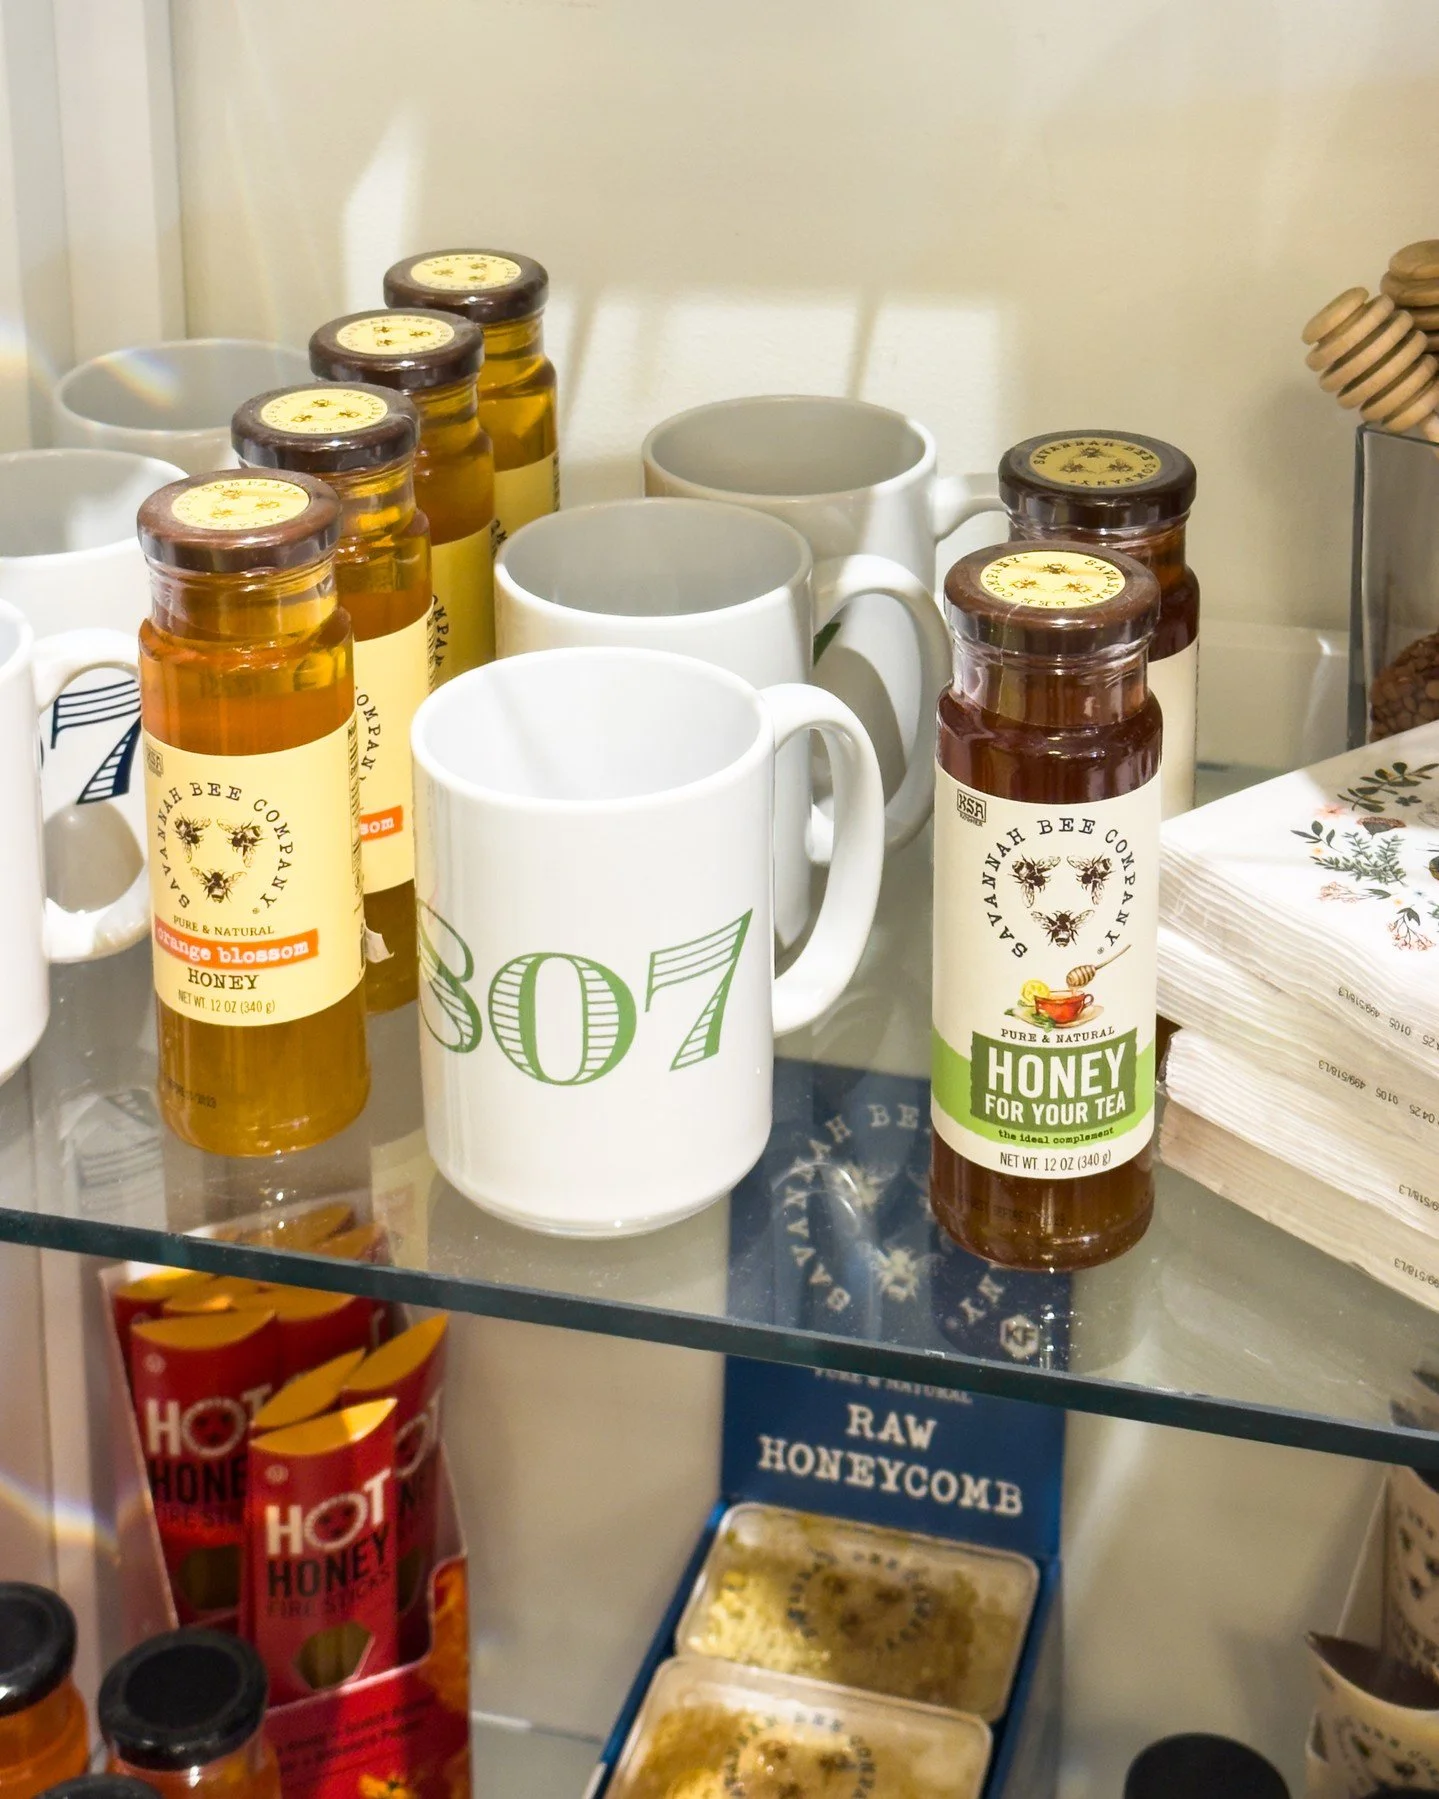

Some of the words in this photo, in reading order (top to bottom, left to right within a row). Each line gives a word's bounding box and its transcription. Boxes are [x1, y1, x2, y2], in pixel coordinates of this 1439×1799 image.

[157, 787, 190, 908] SAVANNAH
[189, 782, 242, 801] BEE
[253, 799, 294, 908] COMPANY
[981, 827, 1028, 958] SAVANNAH
[1036, 817, 1096, 836] BEE
[1104, 828, 1137, 947] COMPANY
[173, 914, 199, 932] PURE
[202, 926, 211, 935] &
[214, 925, 275, 937] NATURAL
[156, 926, 212, 962] orange
[217, 940, 310, 964] blossom
[187, 966, 260, 990] HONEY
[178, 989, 193, 1003] NET
[210, 999, 221, 1012] 12
[224, 1001, 237, 1014] OZ
[240, 1000, 263, 1015] (340
[1001, 1028, 1037, 1042] PURE
[1041, 1035, 1050, 1044] &
[1056, 1026, 1115, 1044] NATURAL
[1388, 1017, 1412, 1037] 0105
[988, 1042, 1126, 1100] HONEY
[985, 1093, 1024, 1124] FOR
[1031, 1101, 1088, 1126] YOUR
[1094, 1090, 1126, 1120] TEA
[1375, 1087, 1399, 1105] 0105
[868, 1104, 932, 1136] BE
[998, 1129, 1017, 1141] the
[1020, 1132, 1049, 1144] ideal
[1053, 1126, 1115, 1145] complement
[1000, 1151, 1020, 1168] NET
[1022, 1154, 1040, 1171] WT.
[1044, 1157, 1056, 1172] 12
[1060, 1157, 1074, 1171] OZ
[1077, 1152, 1100, 1171] (340
[1102, 1149, 1112, 1166] g)
[144, 1383, 273, 1458] HOT
[845, 1402, 938, 1451] RAW
[148, 1454, 248, 1505] HONE
[757, 1433, 1023, 1518] HONEYCOMB
[265, 1466, 392, 1556] HOT
[267, 1520, 390, 1598] HONEY
